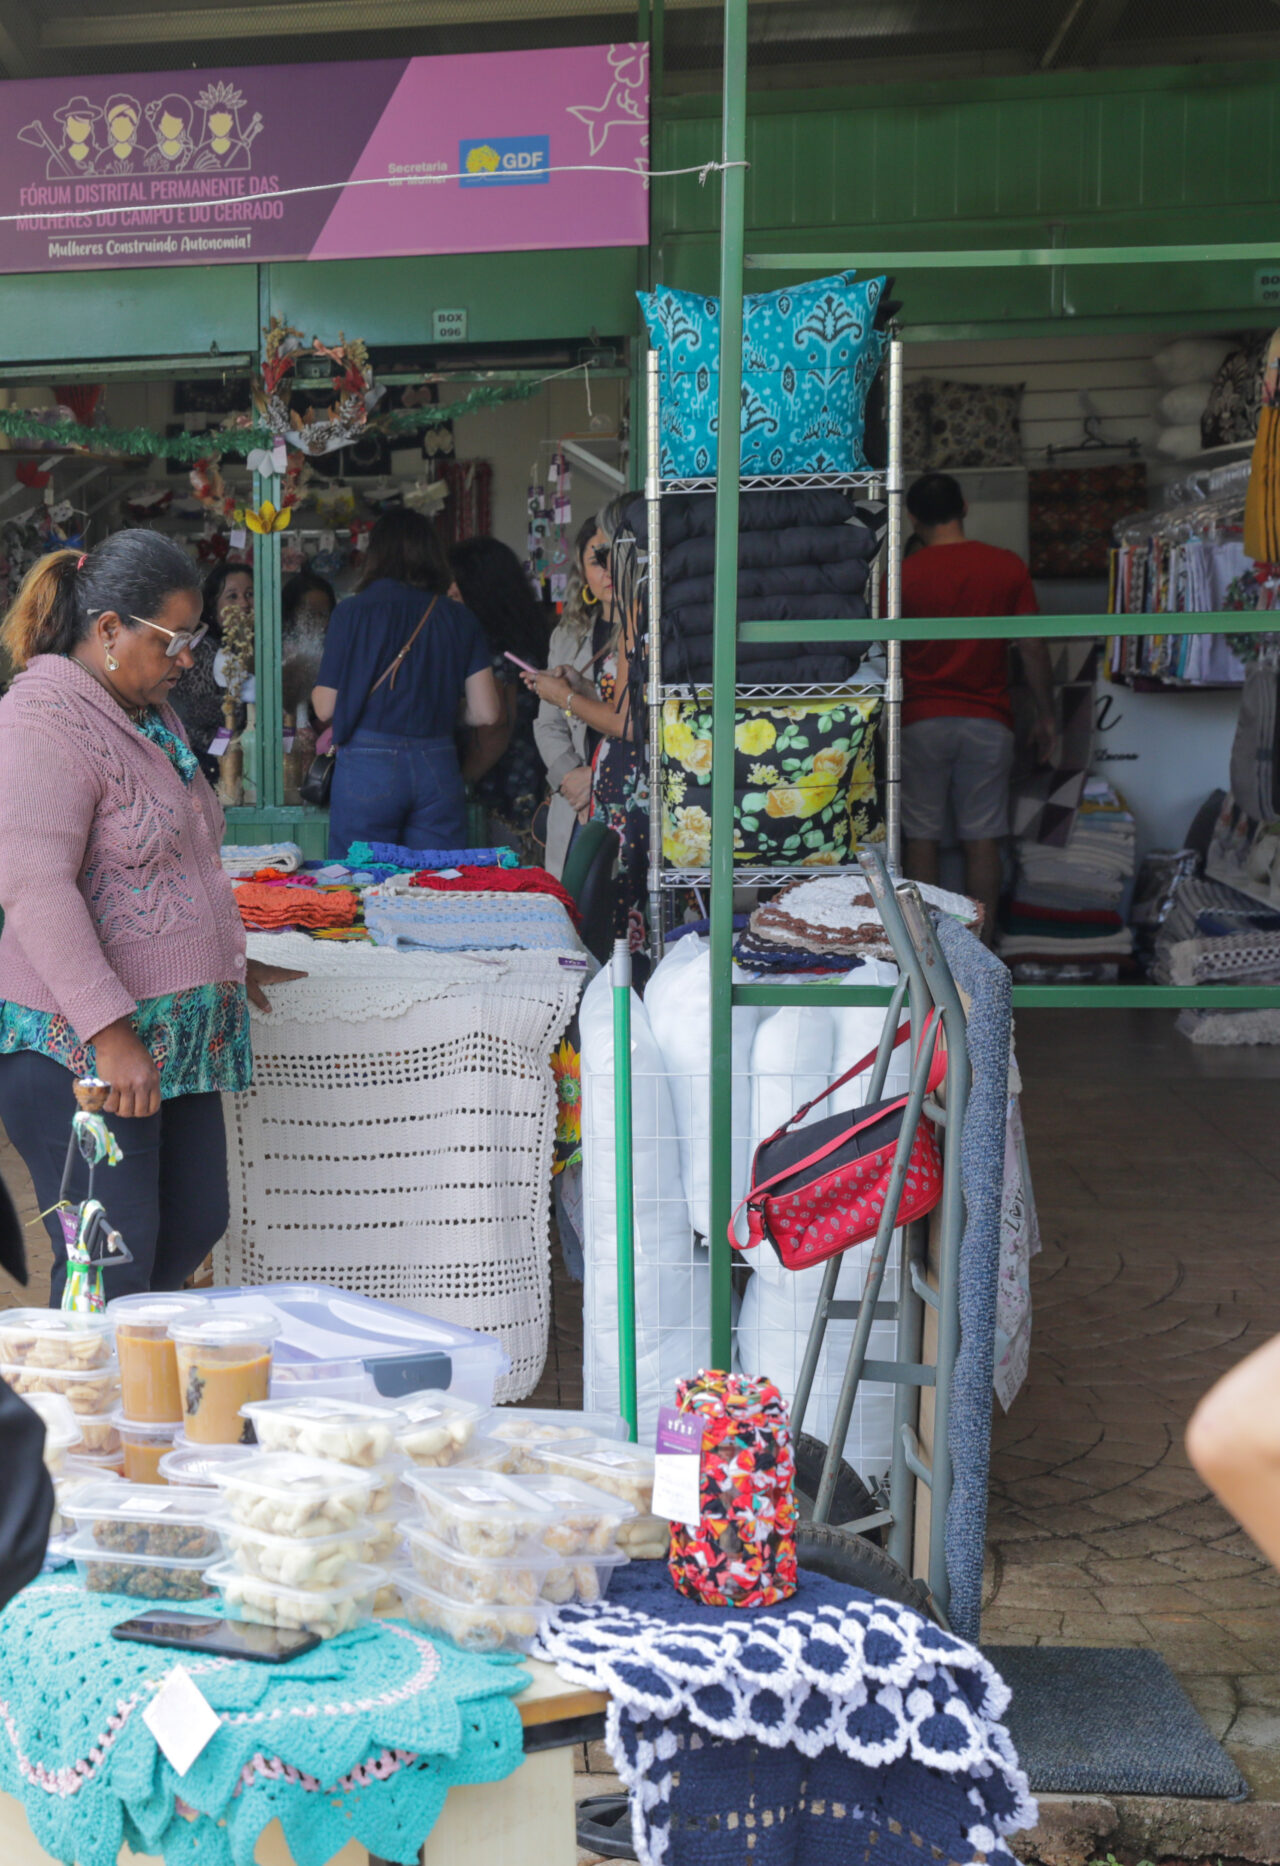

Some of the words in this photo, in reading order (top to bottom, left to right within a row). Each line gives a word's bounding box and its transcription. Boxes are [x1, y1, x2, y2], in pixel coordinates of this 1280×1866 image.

[387, 160, 449, 175] Secretaria
[502, 151, 544, 169] GDF
[19, 182, 71, 207] FÓRUM
[75, 181, 148, 204] DISTRITAL
[150, 176, 246, 201] PERMANENTE
[249, 175, 280, 196] DAS
[16, 208, 93, 232] MULHERES
[96, 207, 118, 227] DO
[121, 203, 174, 226] CAMPO
[177, 203, 186, 224] E
[189, 202, 211, 223] DO
[214, 199, 284, 223] CERRADO
[48, 240, 104, 259] Mulheres
[106, 235, 178, 255] Construindo
[180, 232, 252, 252] Autonomia!
[1261, 275, 1280, 286] BO
[438, 313, 463, 323] BOX
